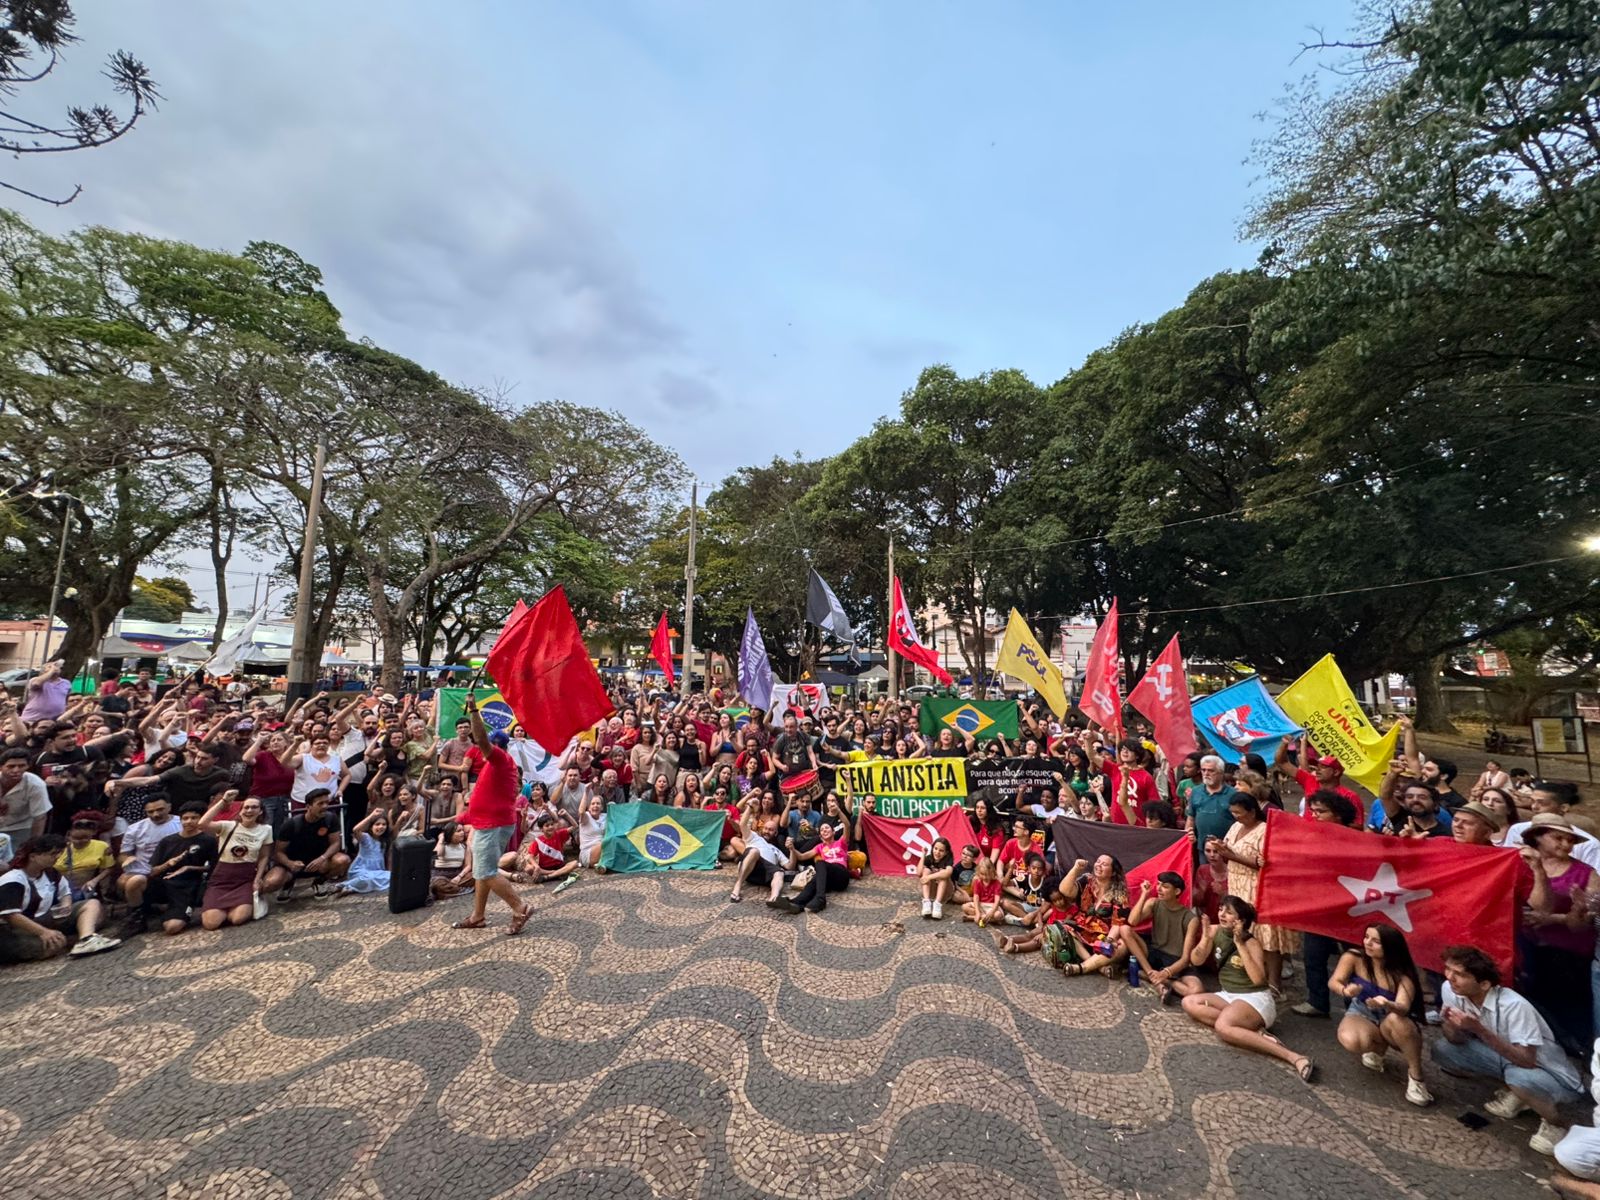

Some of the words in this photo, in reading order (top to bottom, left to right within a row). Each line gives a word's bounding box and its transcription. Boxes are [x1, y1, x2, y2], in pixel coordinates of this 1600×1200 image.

[1308, 714, 1320, 726] DE
[1317, 727, 1356, 769] MORADIA
[1313, 710, 1328, 724] DOS
[1325, 723, 1364, 765] MOVIMENTOS
[839, 766, 874, 792] SEM
[880, 763, 958, 792] ANISTIA
[977, 779, 994, 787] para
[987, 770, 1001, 778] que
[1364, 888, 1404, 905] PT
